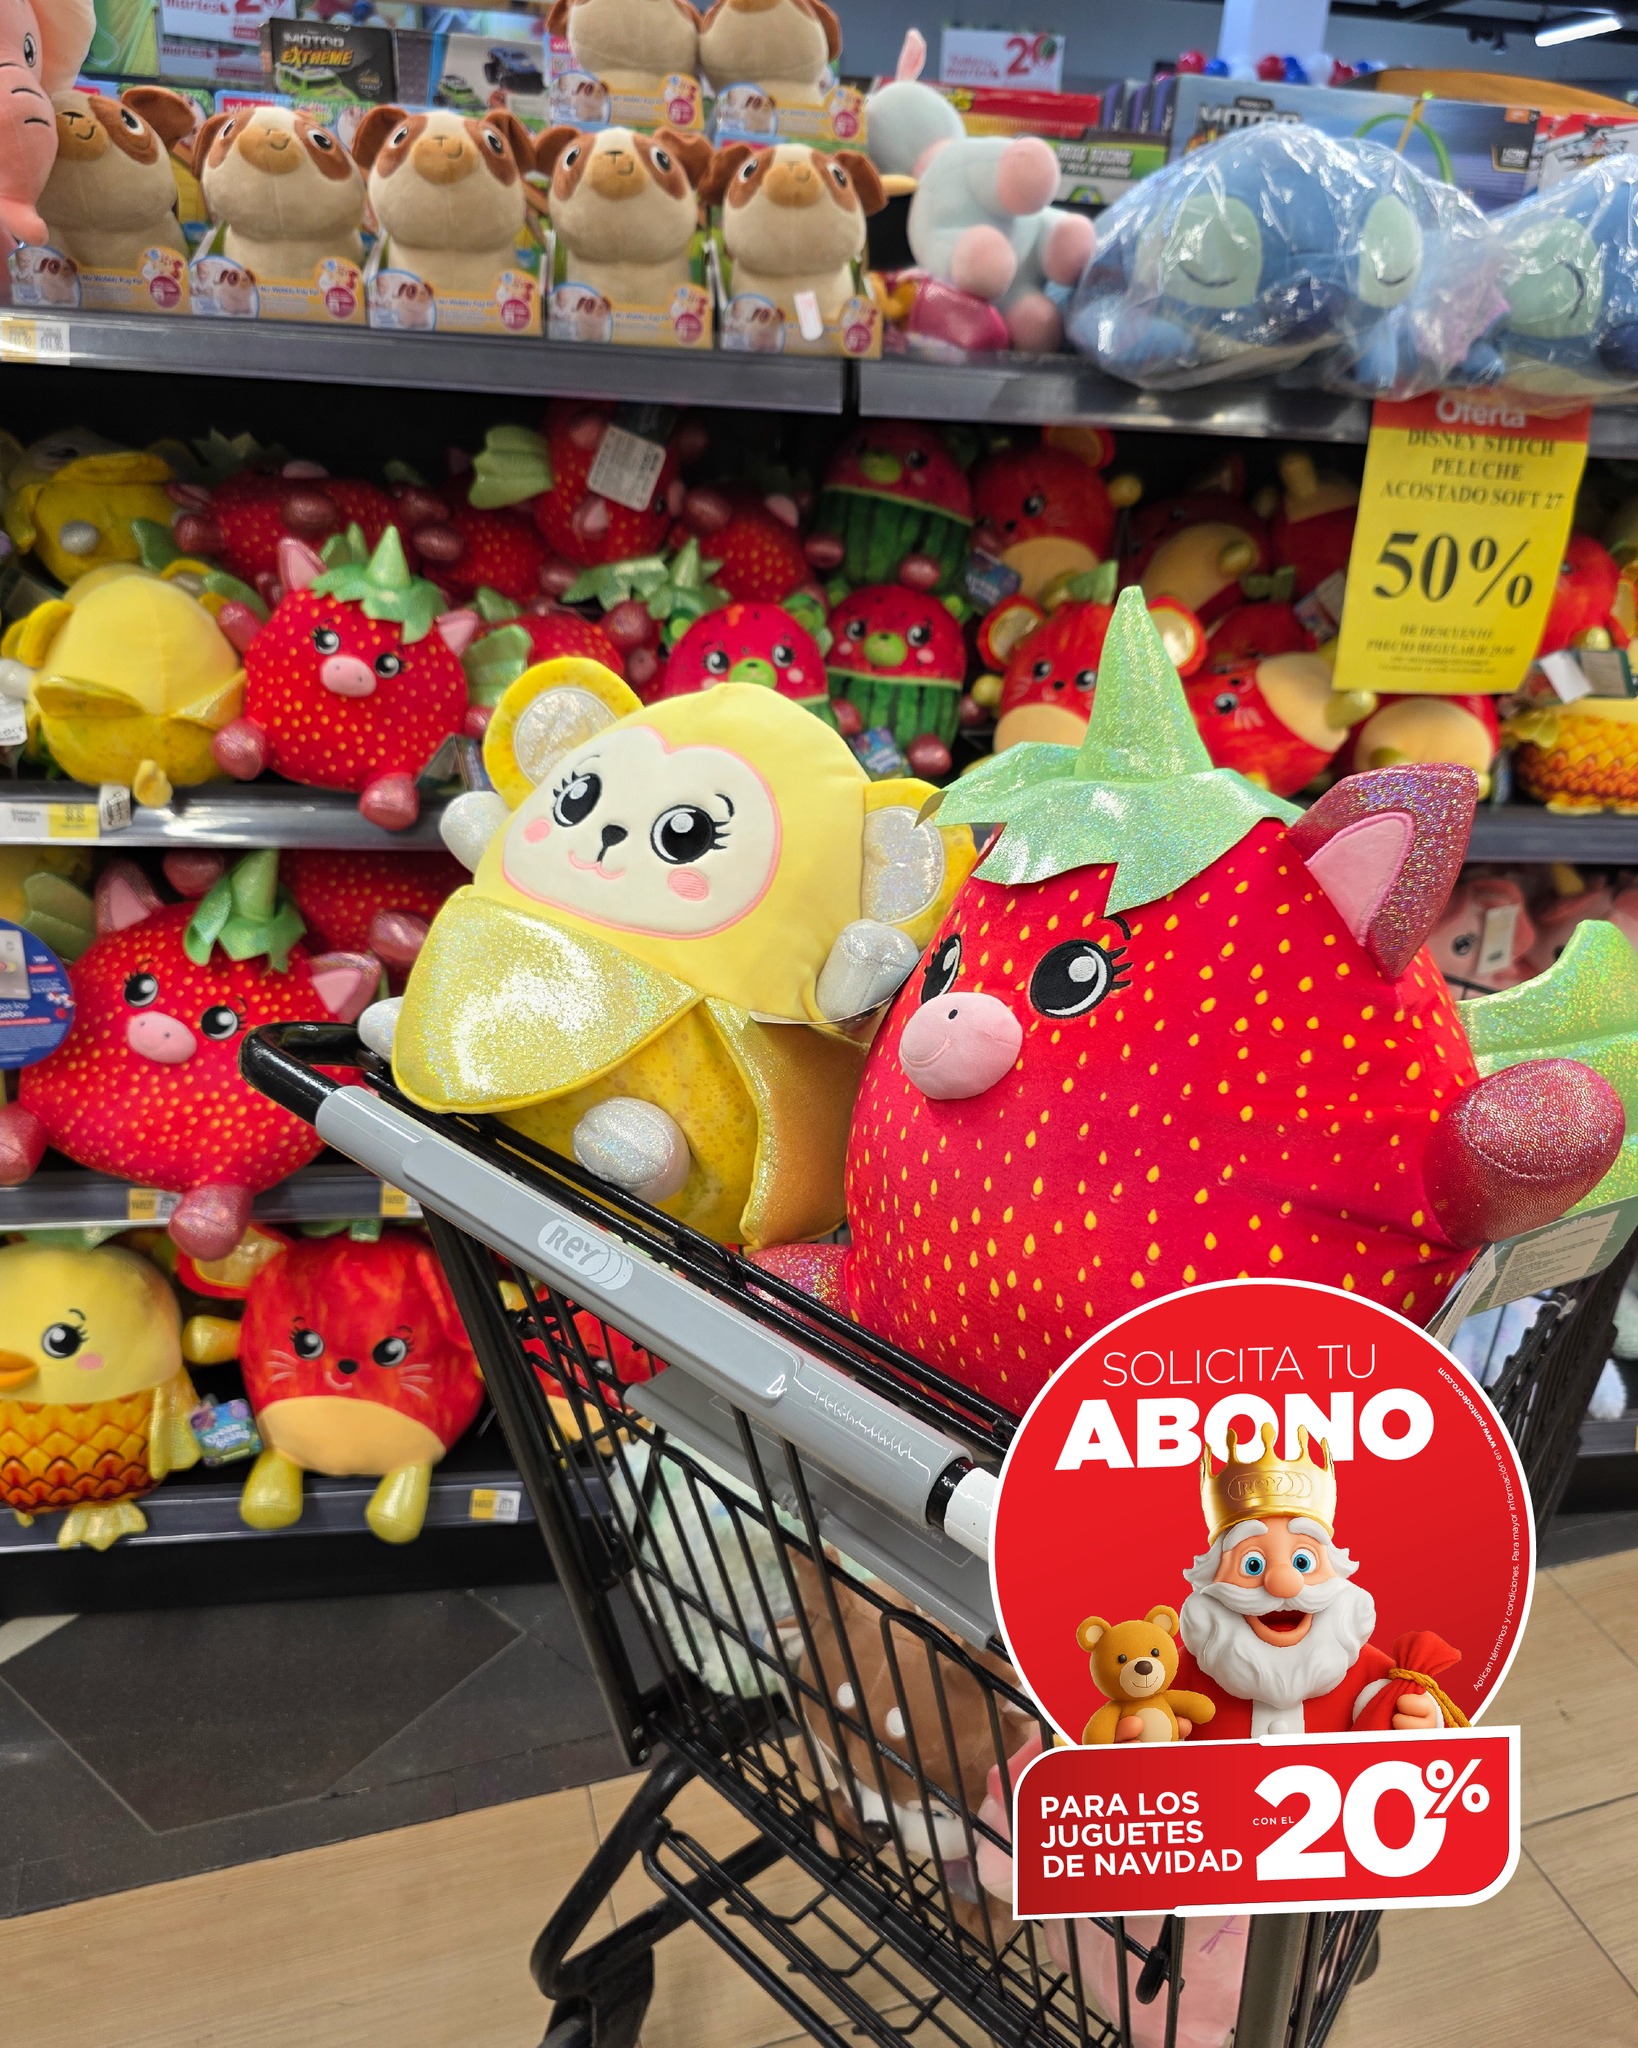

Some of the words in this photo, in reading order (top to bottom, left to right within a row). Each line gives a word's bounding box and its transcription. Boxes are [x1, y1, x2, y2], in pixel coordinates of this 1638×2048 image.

[1436, 396, 1526, 429] Oferta
[1408, 429, 1477, 451] DISNEY
[1484, 436, 1556, 457] STITCH
[1431, 457, 1524, 481] PELUCHE
[1381, 480, 1487, 505] ACOSTADO
[1492, 487, 1541, 509] SOFT
[1372, 531, 1534, 609] 50%
